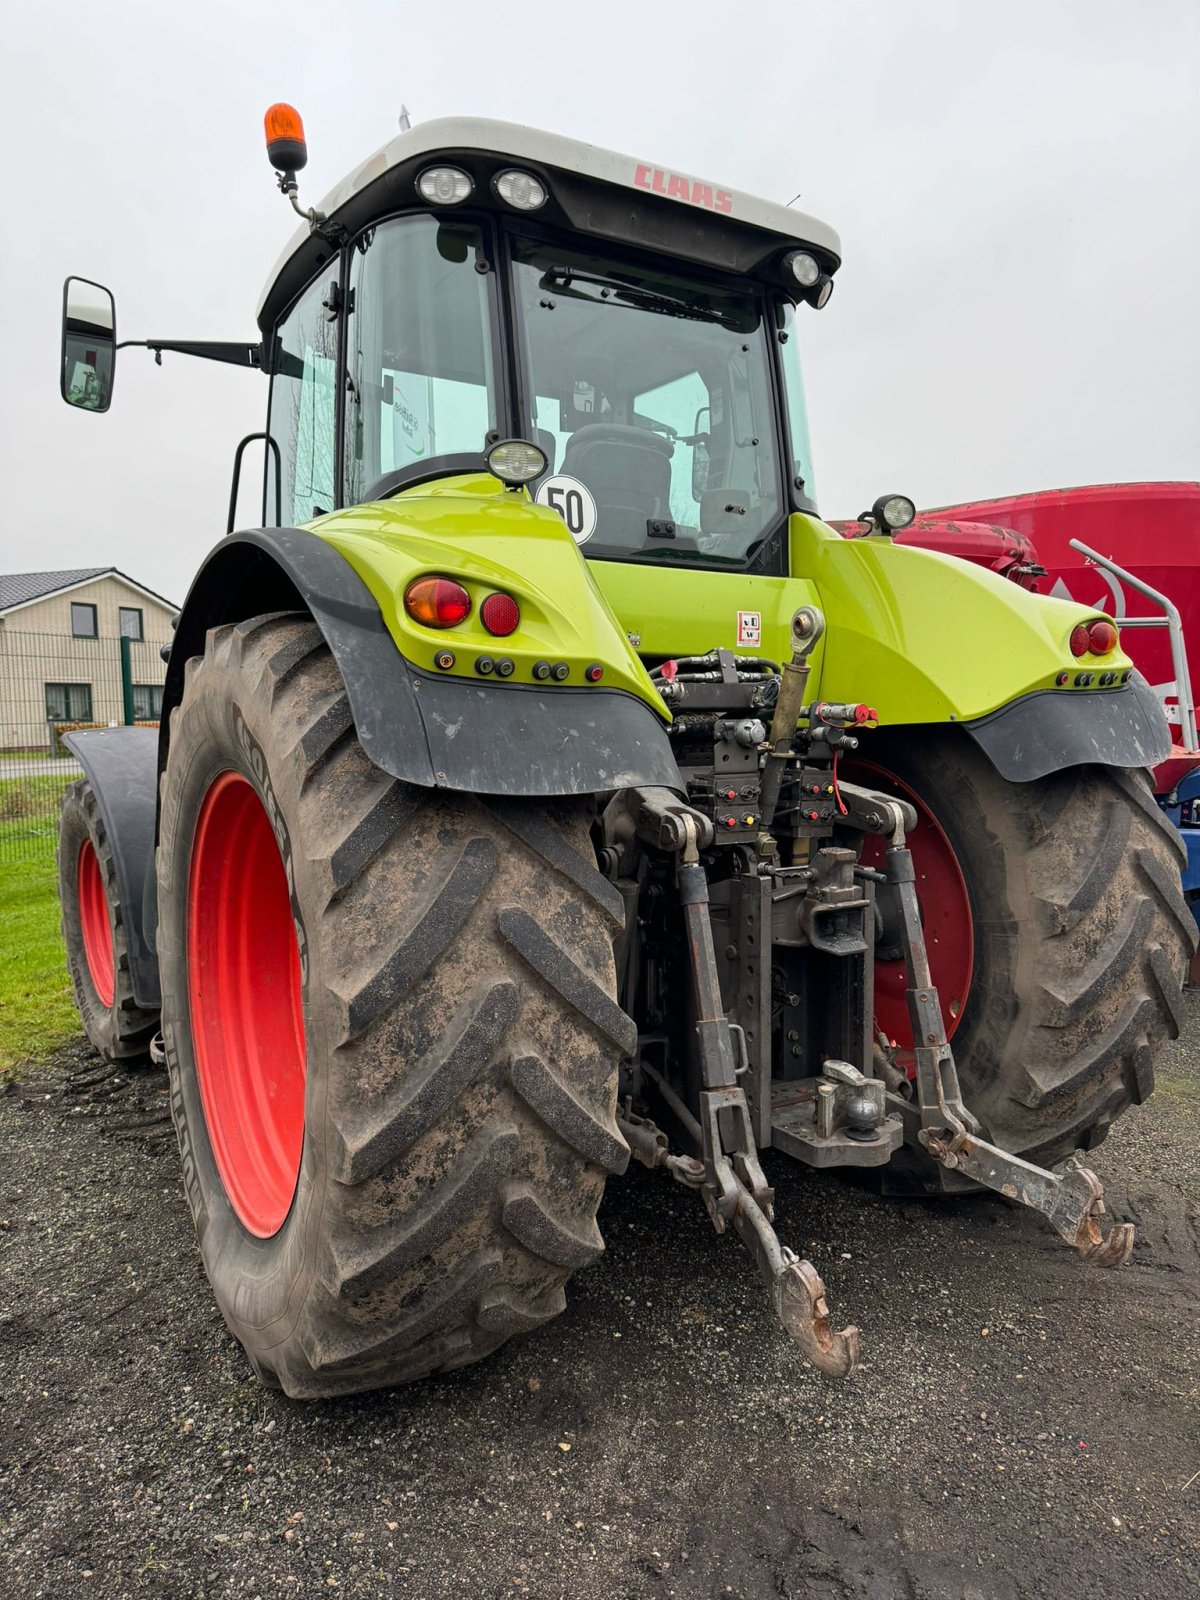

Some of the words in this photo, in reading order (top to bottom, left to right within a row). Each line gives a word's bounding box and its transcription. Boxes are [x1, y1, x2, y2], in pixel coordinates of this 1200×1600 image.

[634, 163, 733, 213] CLAAS
[547, 486, 584, 534] 50
[164, 1022, 202, 1224] MULTIBIB
